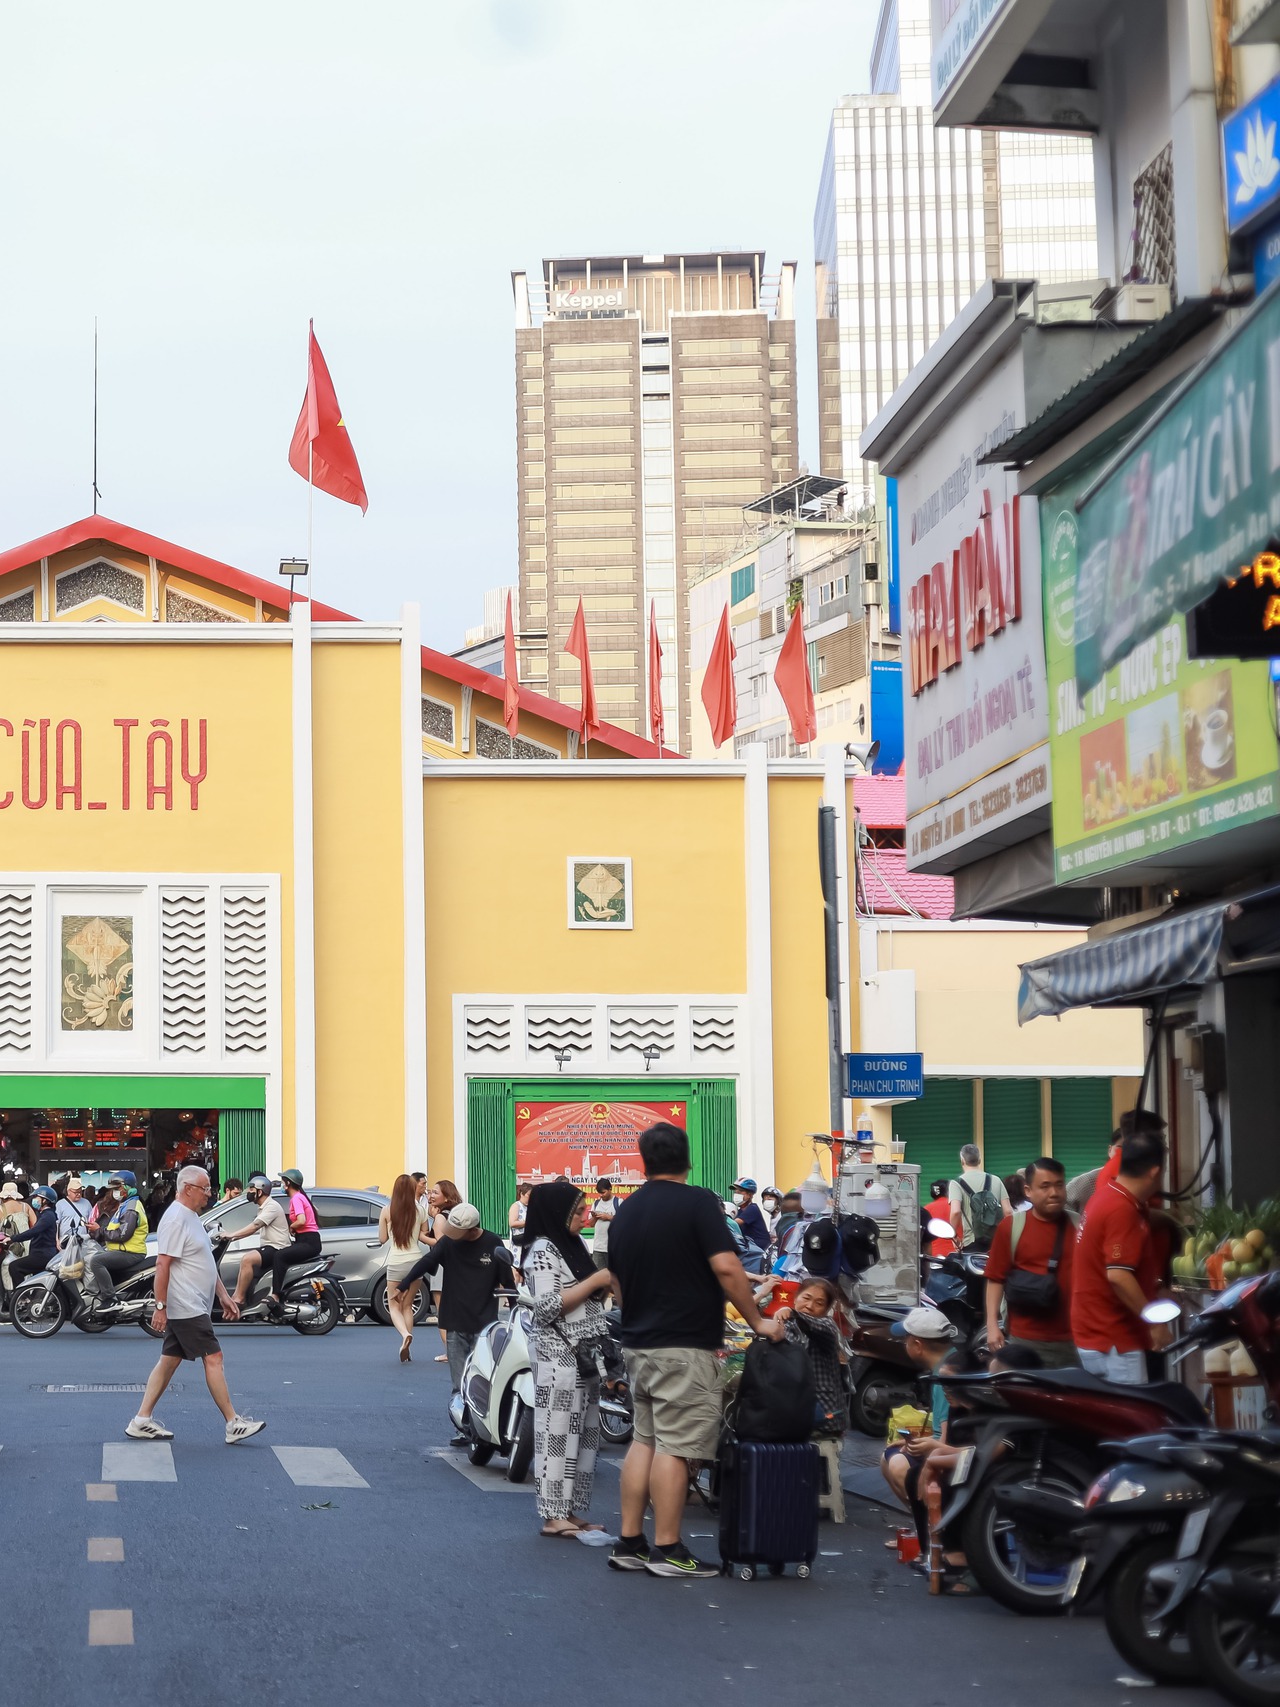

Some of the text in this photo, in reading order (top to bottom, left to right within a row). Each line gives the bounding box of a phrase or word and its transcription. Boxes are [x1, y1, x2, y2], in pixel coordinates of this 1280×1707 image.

[556, 288, 622, 310] Keppel
[933, 716, 945, 770] LÝ
[946, 711, 966, 761] THU
[864, 1059, 907, 1072] ĐƯỜNG
[851, 1079, 920, 1092] PHAN CHU TRINH
